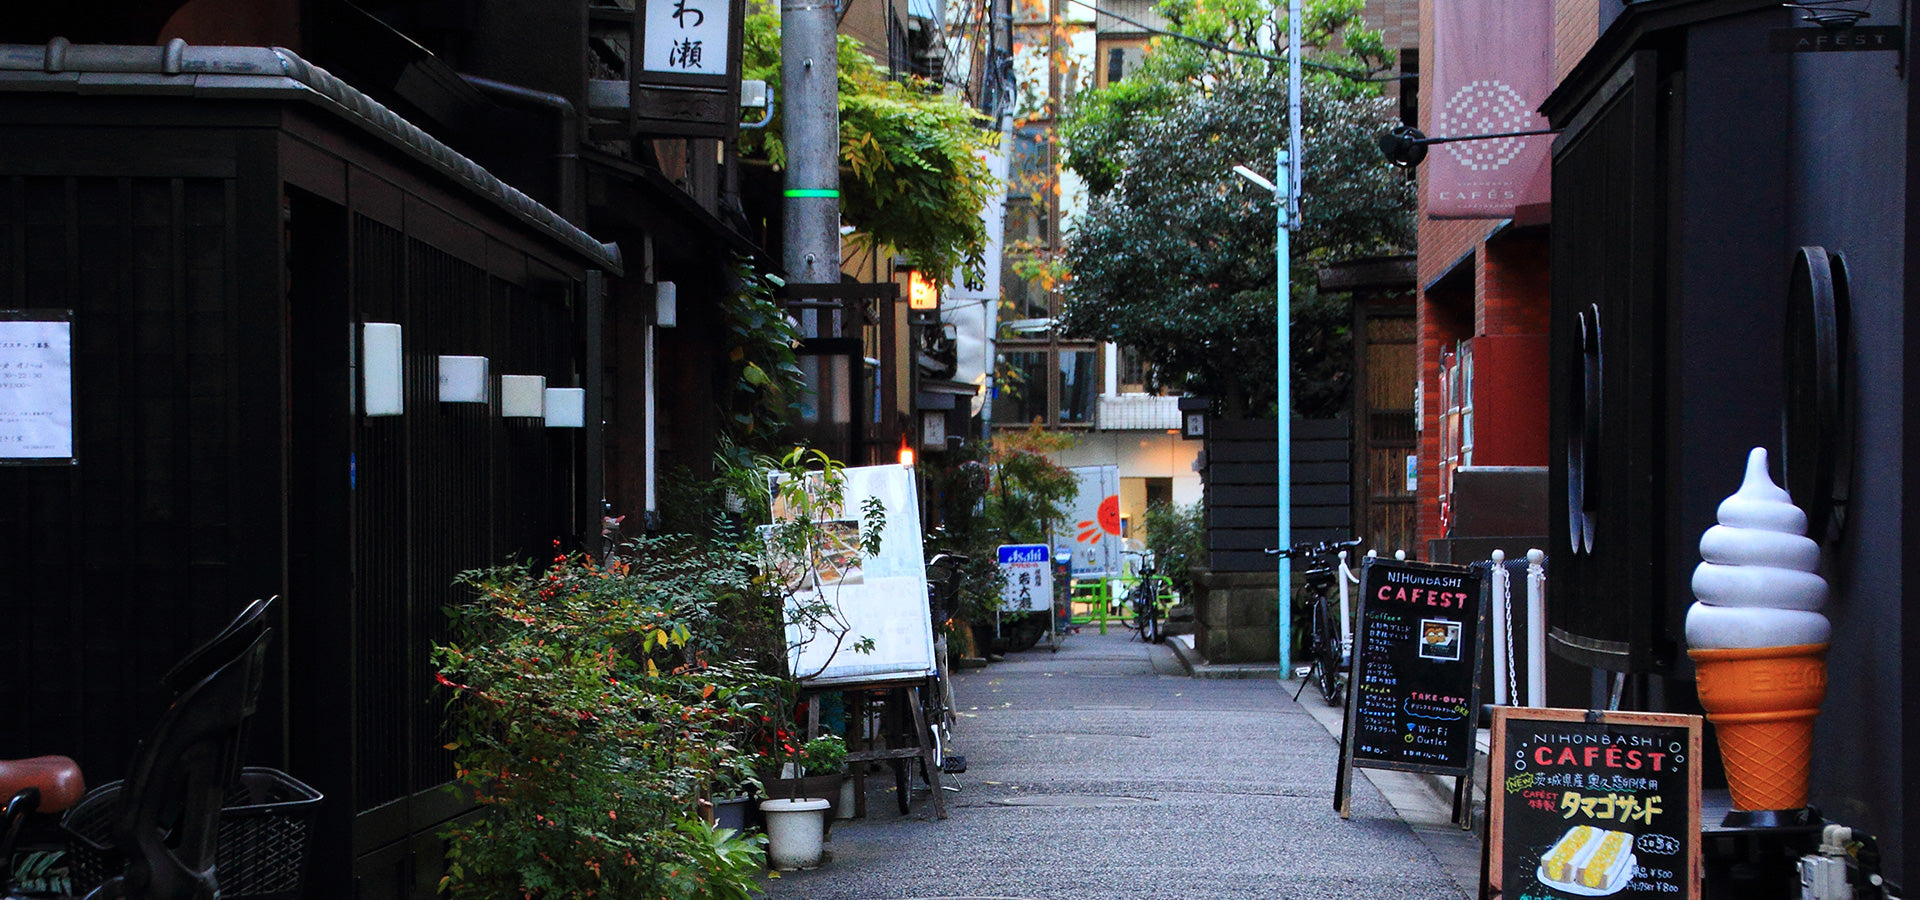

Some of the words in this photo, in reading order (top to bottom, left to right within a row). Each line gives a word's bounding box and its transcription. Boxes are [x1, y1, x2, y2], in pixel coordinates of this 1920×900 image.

[668, 0, 705, 69] わ瀬
[1439, 188, 1525, 200] CAFÉS
[1008, 549, 1042, 562] Asahi
[1387, 571, 1462, 588] NIHONBASHI
[1377, 585, 1468, 609] CAFEST
[1411, 691, 1465, 705] TAKE-OUT
[1416, 735, 1448, 747] Outlet
[1534, 734, 1663, 748] NIHONBASHI
[1534, 745, 1666, 772] CAFÉST
[1509, 777, 1531, 789] NEW
[1534, 772, 1585, 788] 茨城県産
[1560, 791, 1663, 825] タマゴサンド
[1650, 868, 1673, 879] ¥500
[1656, 881, 1679, 893] ¥800
